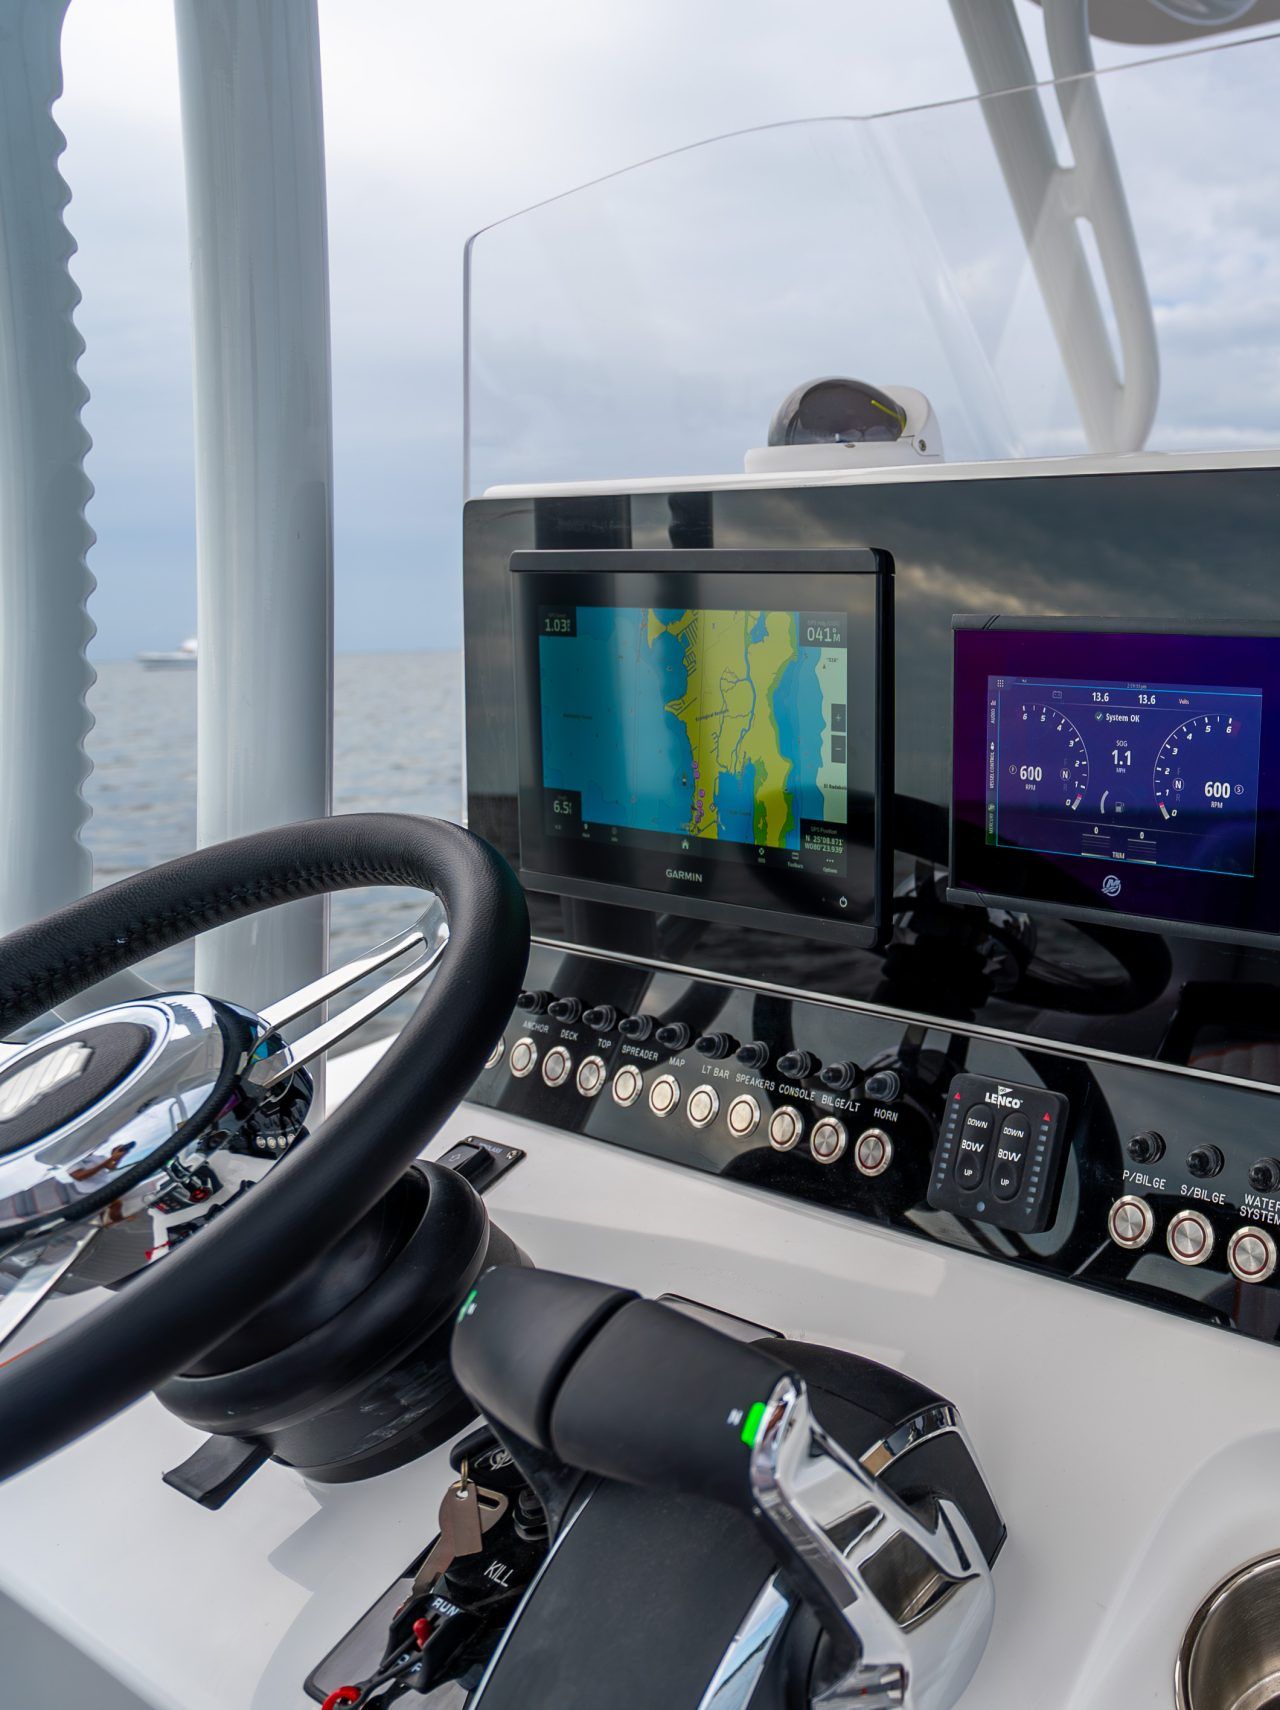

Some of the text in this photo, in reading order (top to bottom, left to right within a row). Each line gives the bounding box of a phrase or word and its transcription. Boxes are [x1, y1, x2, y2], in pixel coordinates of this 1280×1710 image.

[544, 619, 567, 632] 1.03
[807, 627, 832, 642] 041
[1092, 692, 1110, 702] 13.6
[1138, 695, 1156, 705] 13.6
[1106, 713, 1140, 723] System OK
[1112, 749, 1131, 766] 1.1
[1019, 765, 1043, 782] 600
[1025, 783, 1036, 792] RPM
[1204, 781, 1231, 799] 600
[553, 801, 568, 814] 6.5
[1210, 801, 1223, 809] RPM
[665, 868, 703, 882] GARMIN
[522, 1020, 549, 1033] ANCHOR
[560, 1029, 579, 1041] DECK
[597, 1038, 612, 1049] TOP
[621, 1044, 659, 1061] SPREADER
[668, 1056, 686, 1067] MAP
[701, 1064, 730, 1080] LT BAR
[735, 1073, 776, 1091] SPEAKERS
[778, 1084, 816, 1101] CONSOLE
[984, 1092, 1021, 1109] LENCO
[821, 1094, 861, 1113] BILGE/LT
[873, 1107, 898, 1122] HORN
[967, 1117, 1025, 1138] DOWN DOWN
[961, 1139, 1022, 1162] BOW BOW
[1122, 1170, 1167, 1190] P/BILGE
[1180, 1184, 1226, 1205] S/BILGE
[484, 1560, 514, 1588] KILL
[432, 1597, 462, 1617] RUN
[397, 1654, 423, 1673] OF
